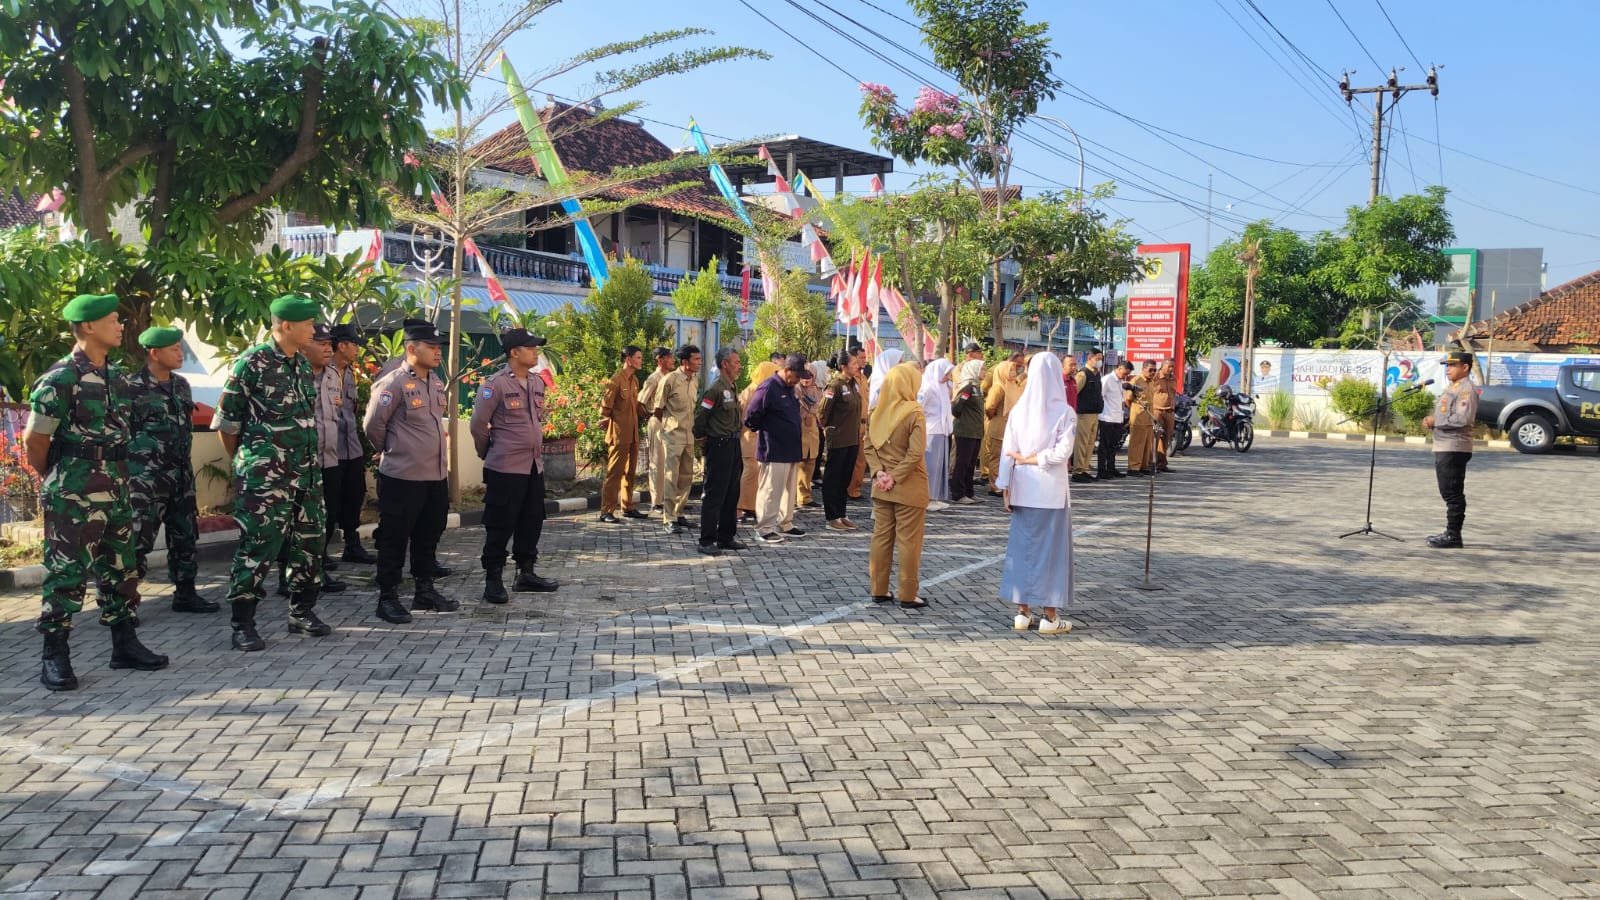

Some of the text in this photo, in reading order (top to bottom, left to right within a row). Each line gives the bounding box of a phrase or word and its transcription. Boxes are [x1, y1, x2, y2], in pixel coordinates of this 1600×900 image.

[1292, 366, 1372, 375] HARI JADI KE-221
[1291, 374, 1334, 383] KLATEN
